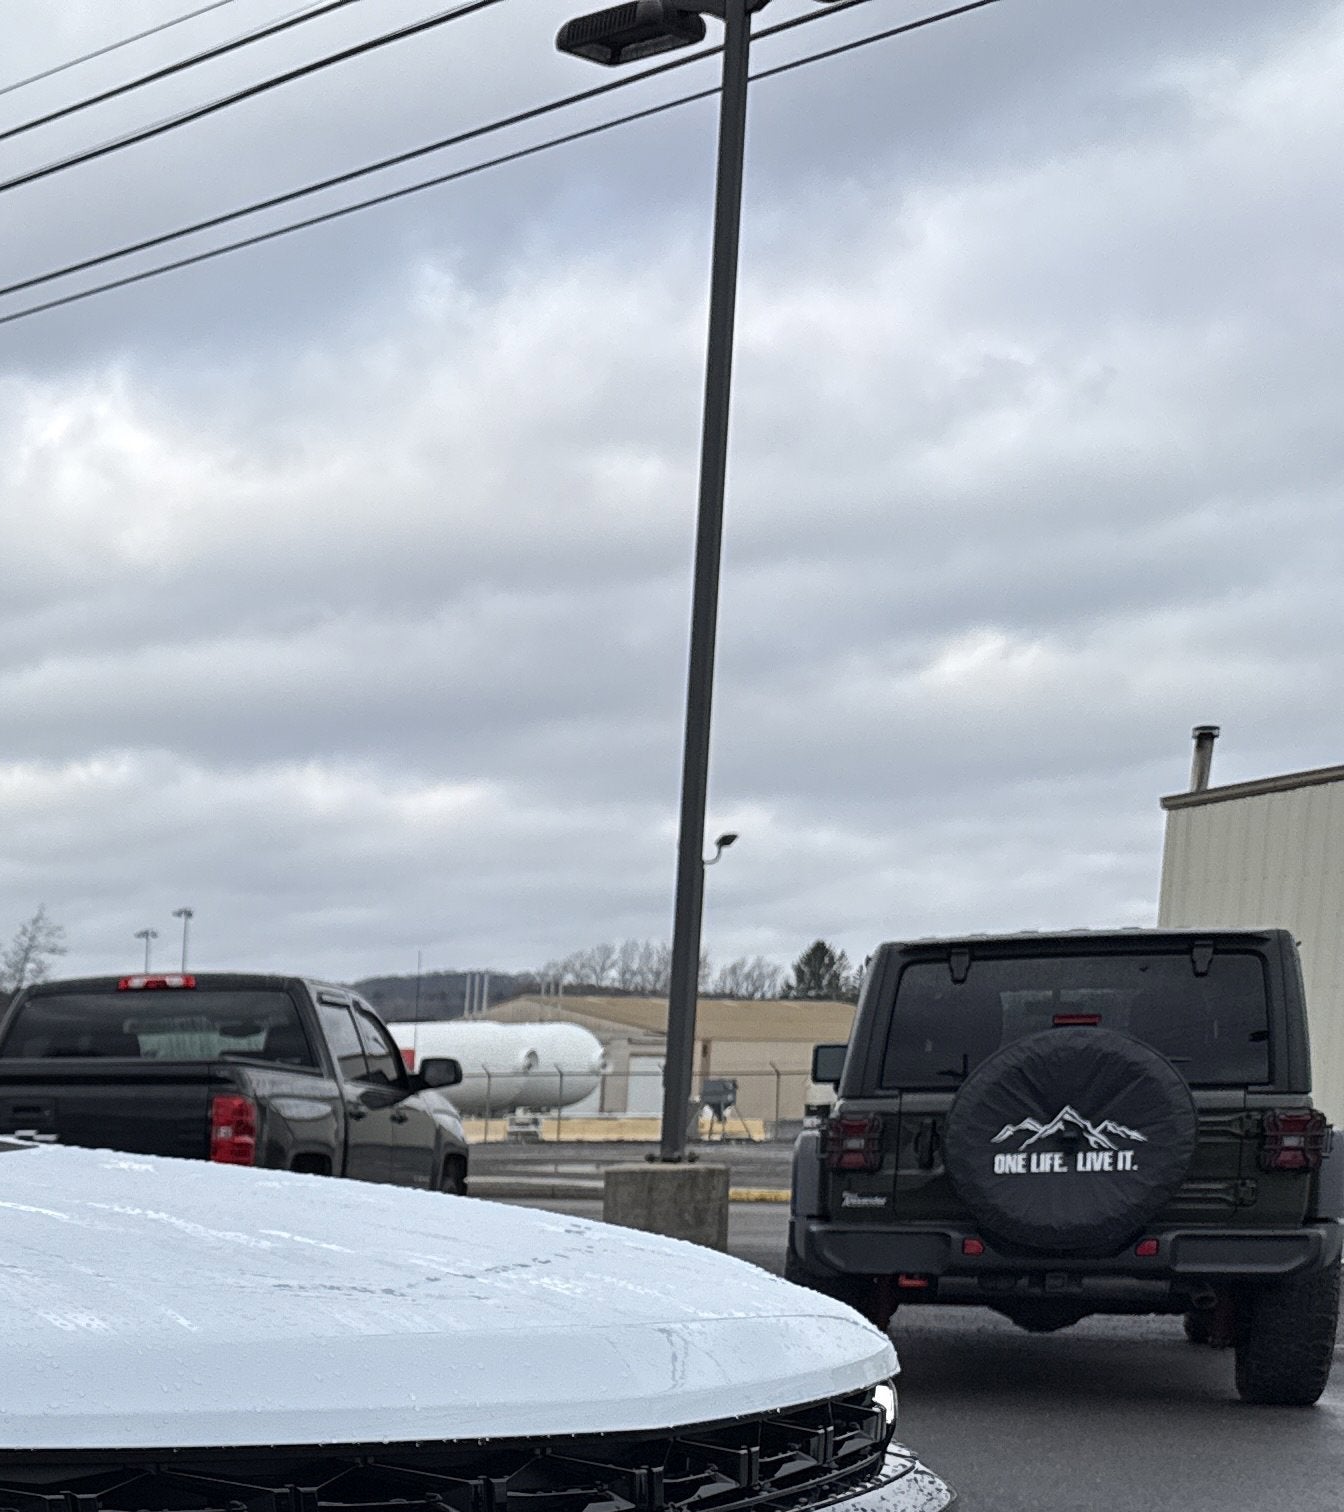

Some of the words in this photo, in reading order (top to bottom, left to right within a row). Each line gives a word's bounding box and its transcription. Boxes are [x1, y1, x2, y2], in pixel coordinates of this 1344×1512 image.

[993, 1152, 1027, 1174] ONE
[1030, 1151, 1069, 1173] LIFE.
[1076, 1150, 1113, 1172] LIVE
[1117, 1150, 1139, 1171] IT.
